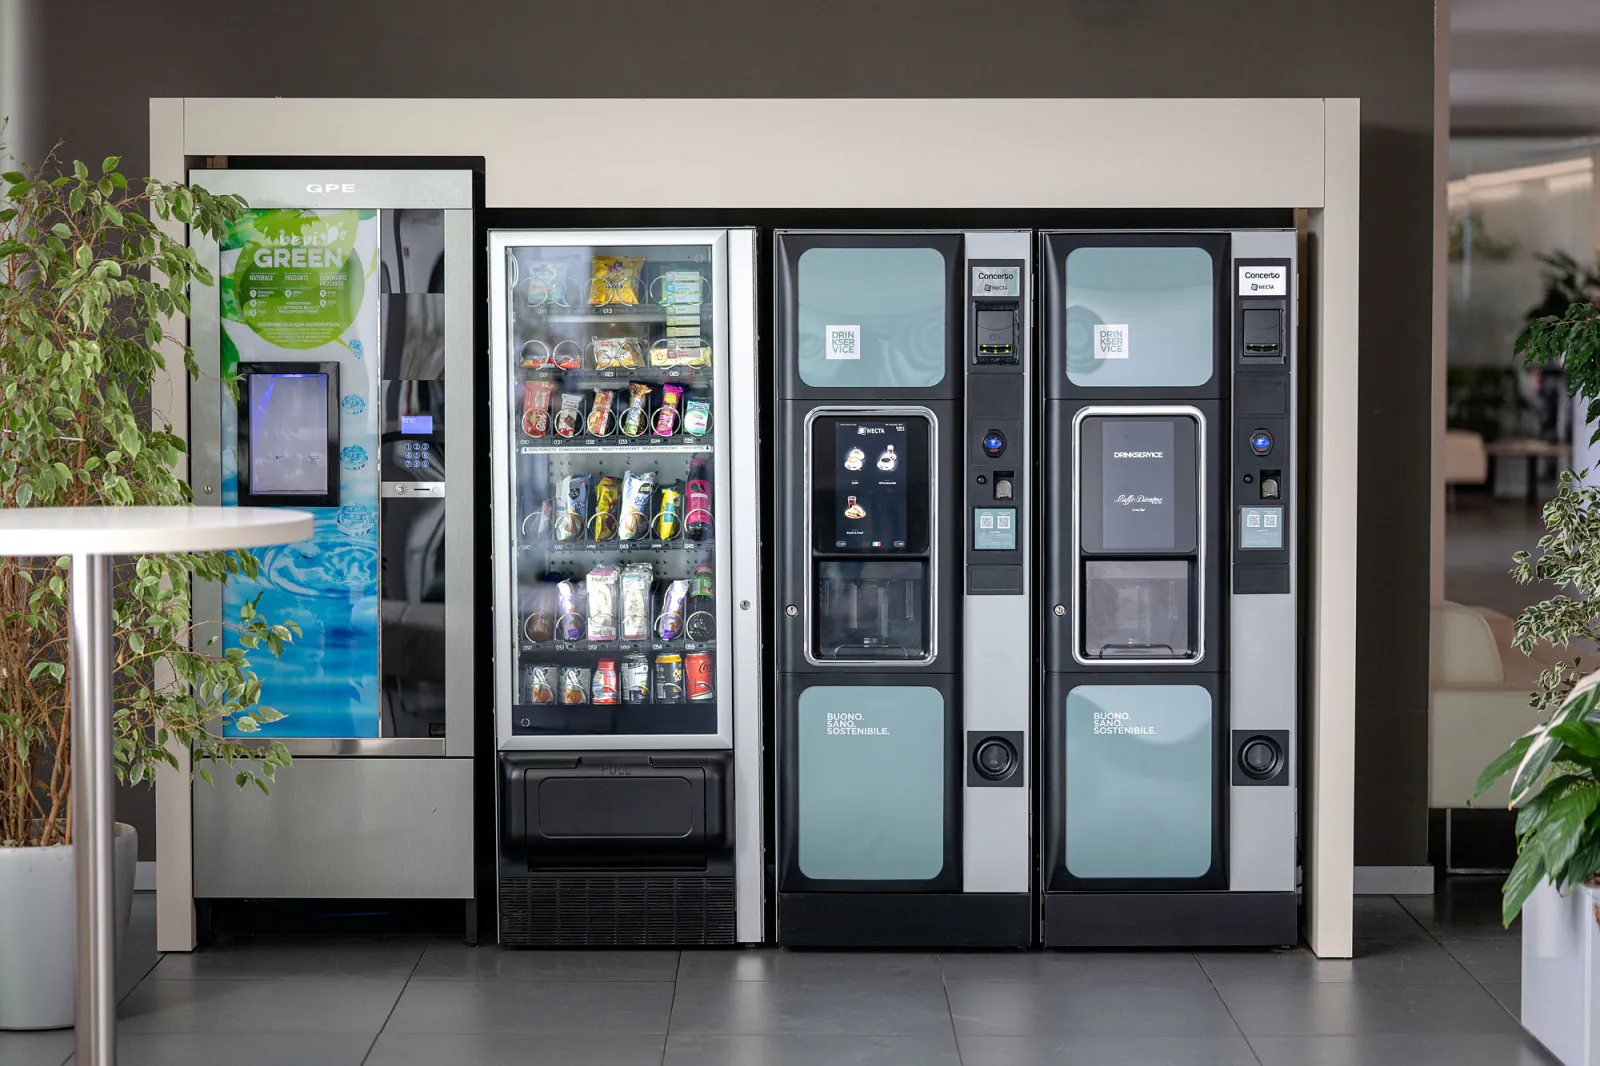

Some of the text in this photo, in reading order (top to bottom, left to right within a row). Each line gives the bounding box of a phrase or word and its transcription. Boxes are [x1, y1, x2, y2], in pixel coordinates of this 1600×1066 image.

[306, 184, 356, 193] GPE
[280, 229, 320, 246] bevi
[254, 248, 342, 268] GREEN
[601, 764, 631, 775] PULL
